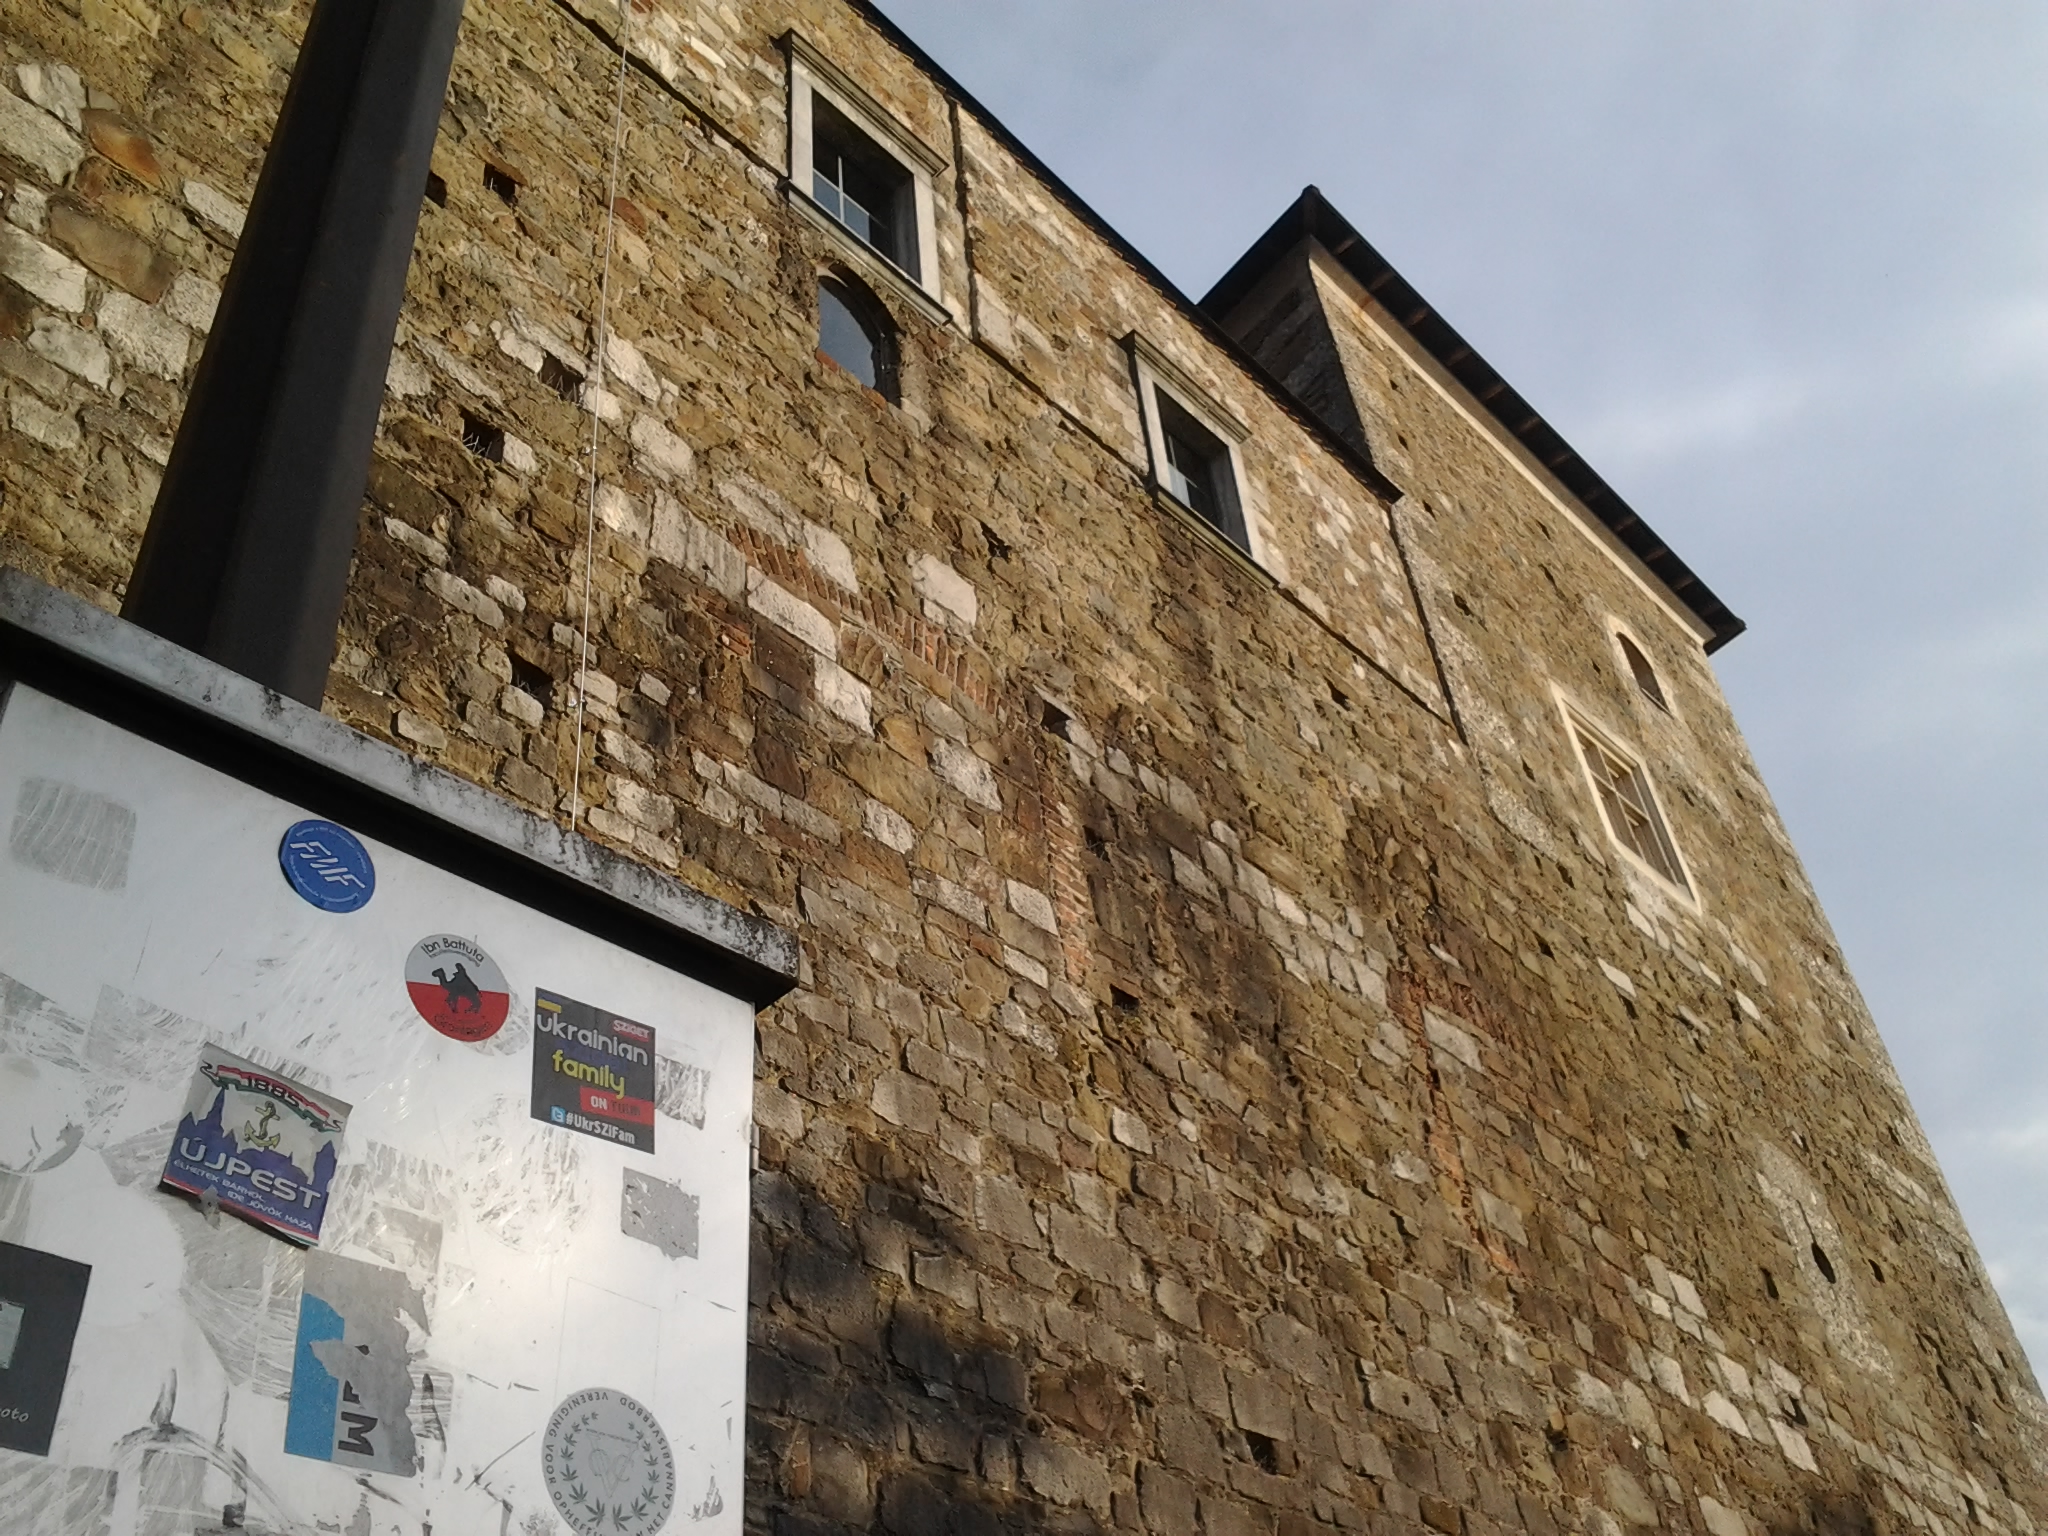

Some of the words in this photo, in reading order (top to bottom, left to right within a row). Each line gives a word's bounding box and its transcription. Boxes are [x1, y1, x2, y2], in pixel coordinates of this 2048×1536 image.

[420, 941, 442, 959] Ibn
[442, 937, 485, 963] Battuta
[552, 1049, 625, 1100] family
[247, 1077, 300, 1108] 1885
[590, 1095, 608, 1111] ON
[179, 1137, 322, 1209] ÚJPEST
[0, 1407, 30, 1424] oto
[548, 1391, 609, 1438] VERENIGING
[545, 1444, 557, 1484] VOOR
[619, 1397, 674, 1510] CANNABISVERBOD
[646, 1512, 666, 1536] HET
